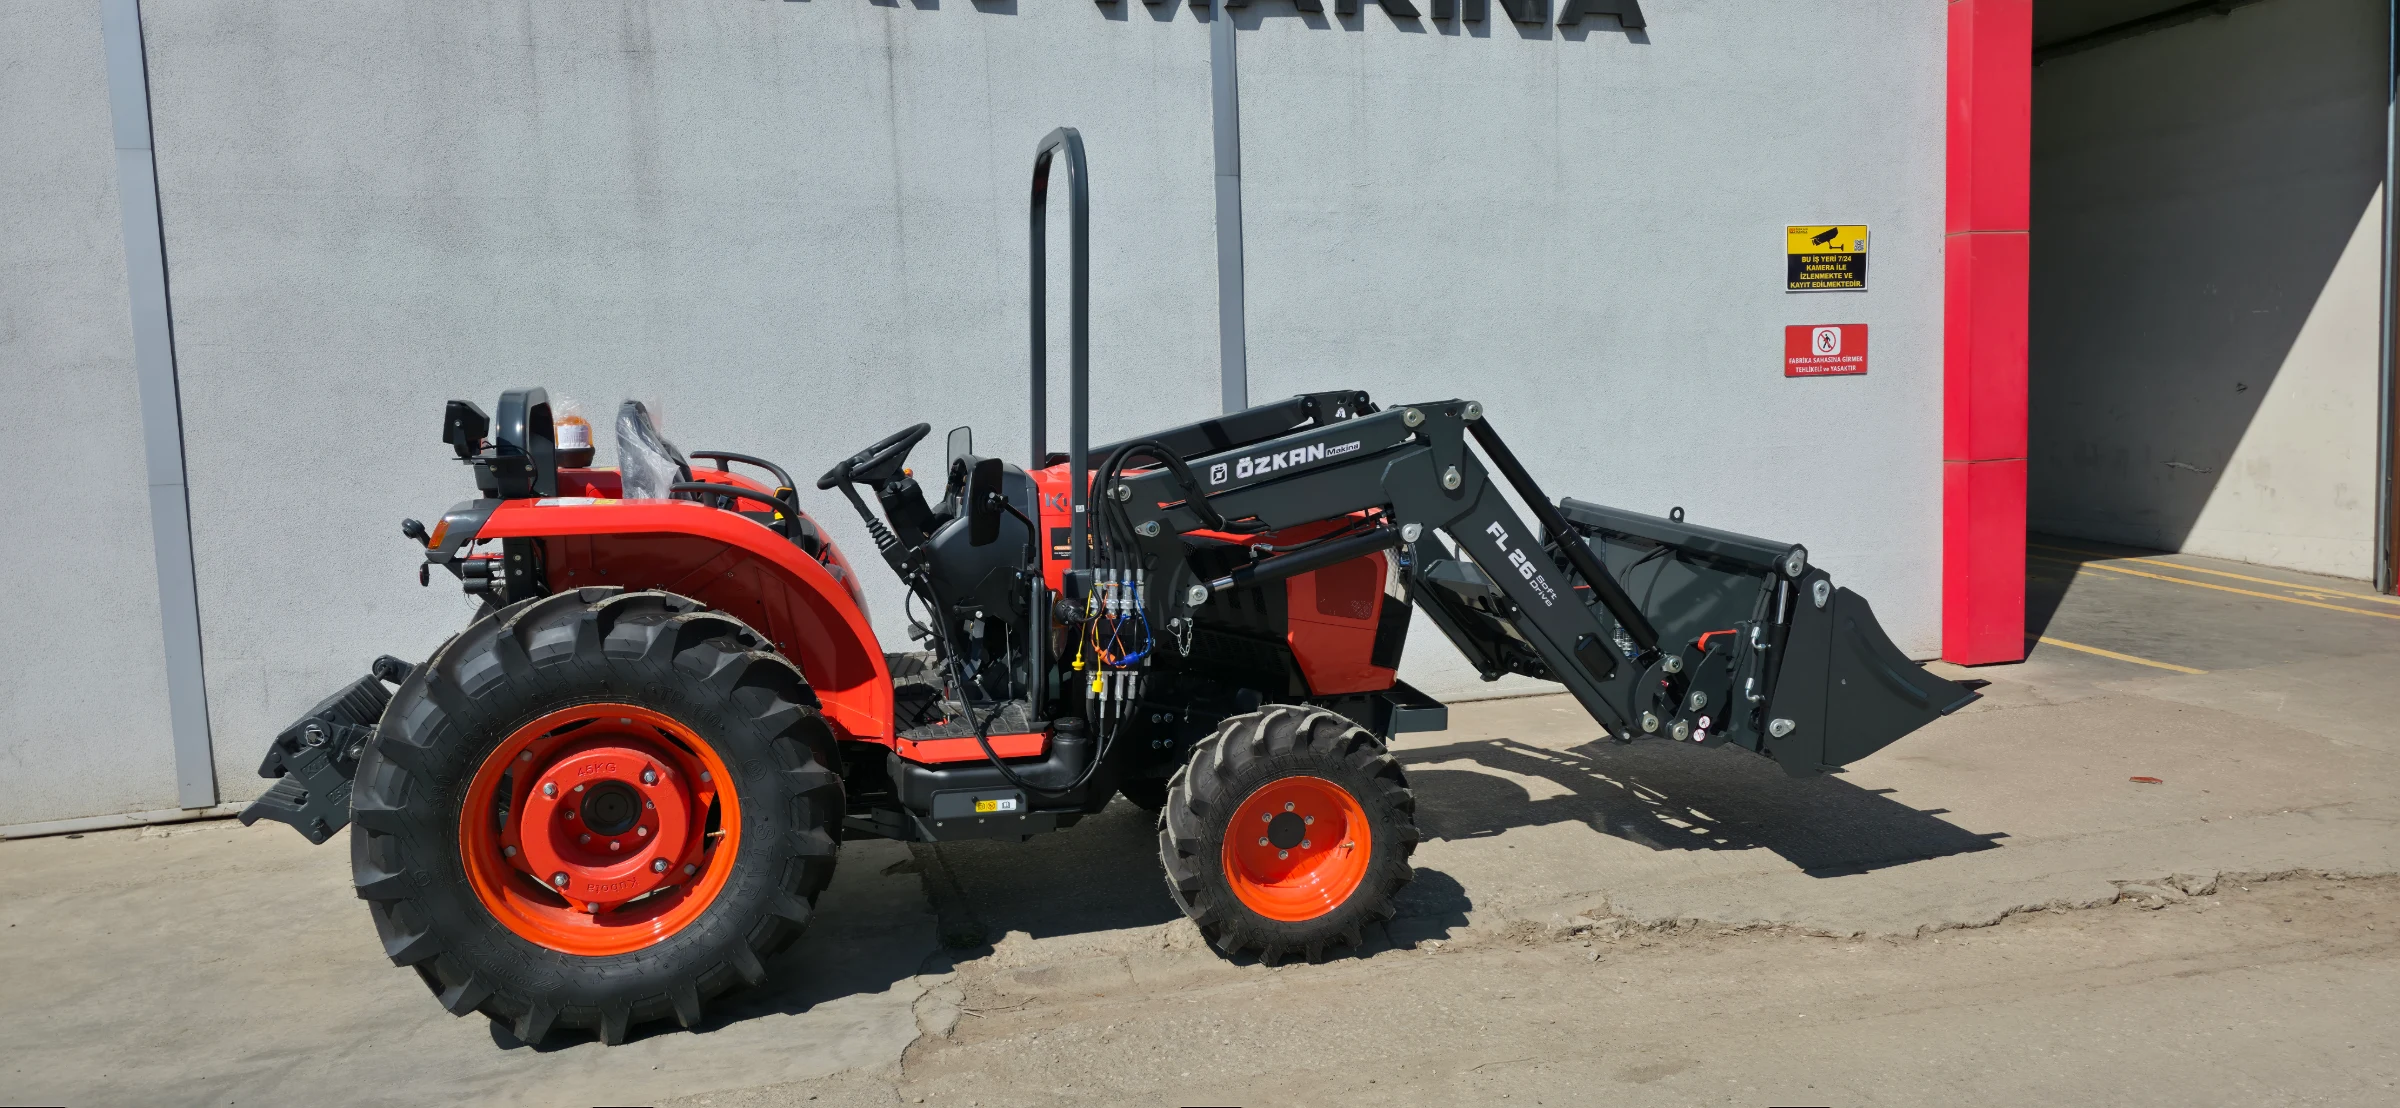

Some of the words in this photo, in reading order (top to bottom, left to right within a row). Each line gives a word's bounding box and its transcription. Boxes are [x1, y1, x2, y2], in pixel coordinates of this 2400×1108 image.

[1812, 255, 1820, 264] İŞ
[1820, 255, 1837, 263] YERİ
[1836, 263, 1847, 271] İLE
[1800, 271, 1843, 280] İZLENMEKTE
[1790, 281, 1811, 289] KAYIT
[1811, 279, 1863, 288] EDİLMEKTEDİR.
[1789, 356, 1812, 364] FABRİKA
[1812, 356, 1841, 364] SAHASINA
[1842, 355, 1863, 363] GİRMEK
[1795, 364, 1823, 373] TEHLİKELİ
[1830, 364, 1857, 372] YASAKTIR
[1236, 442, 1325, 479] ÖZKAN
[1327, 443, 1360, 456] Makina
[1485, 520, 1509, 552] FL
[1507, 548, 1538, 580] 26
[1535, 574, 1558, 600] Soft
[1529, 579, 1553, 607] Drive
[586, 876, 640, 895] Kubota
